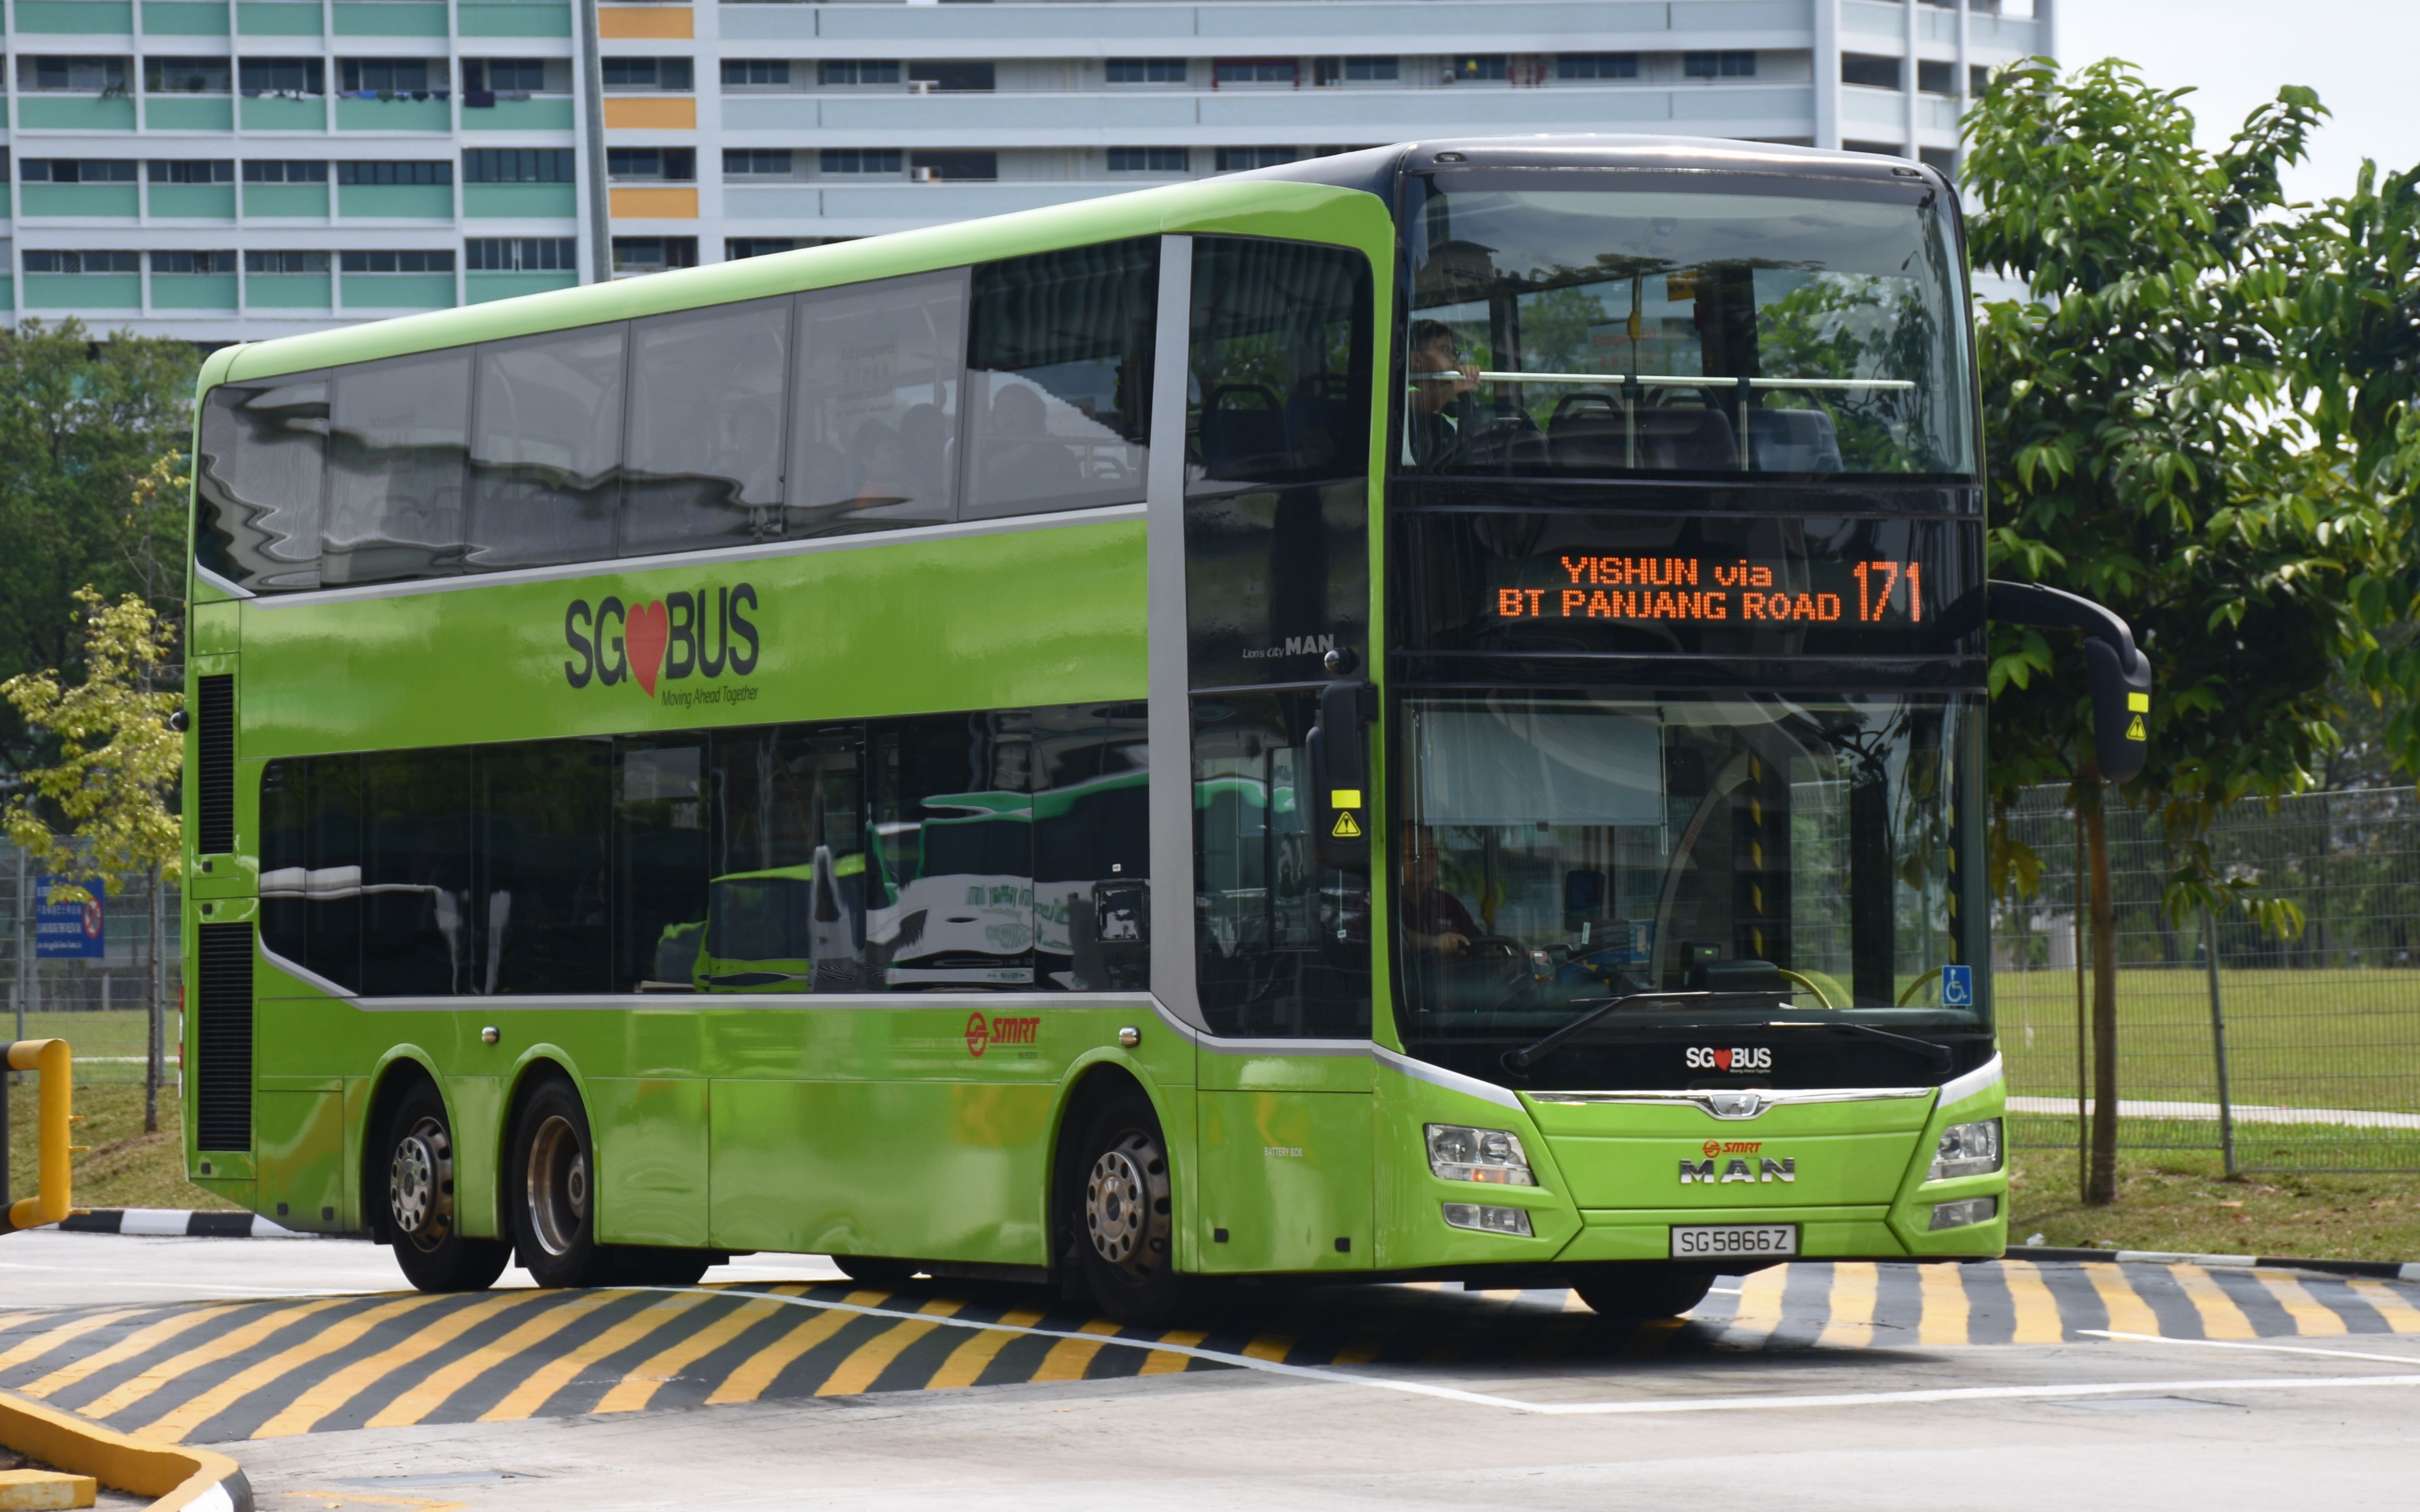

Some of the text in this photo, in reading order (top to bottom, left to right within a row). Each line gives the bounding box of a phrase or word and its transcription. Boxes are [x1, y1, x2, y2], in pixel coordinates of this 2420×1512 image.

[1561, 556, 1773, 587] YISHUN via
[1499, 588, 1841, 621] BT PANJANG ROAD
[1853, 561, 1920, 623] 171
[665, 582, 759, 680] BUS
[1266, 646, 1285, 658] City
[1285, 633, 1335, 656] MAN
[661, 684, 758, 709] Moving Ahead Together
[989, 1017, 1041, 1044] SMRT
[1730, 1047, 1772, 1068] BUS
[1264, 1147, 1303, 1157] BATTERY BOX
[1721, 1142, 1763, 1154] SMRT
[1679, 1157, 1796, 1184] MAN
[1681, 1229, 1788, 1253] SG5866Z
